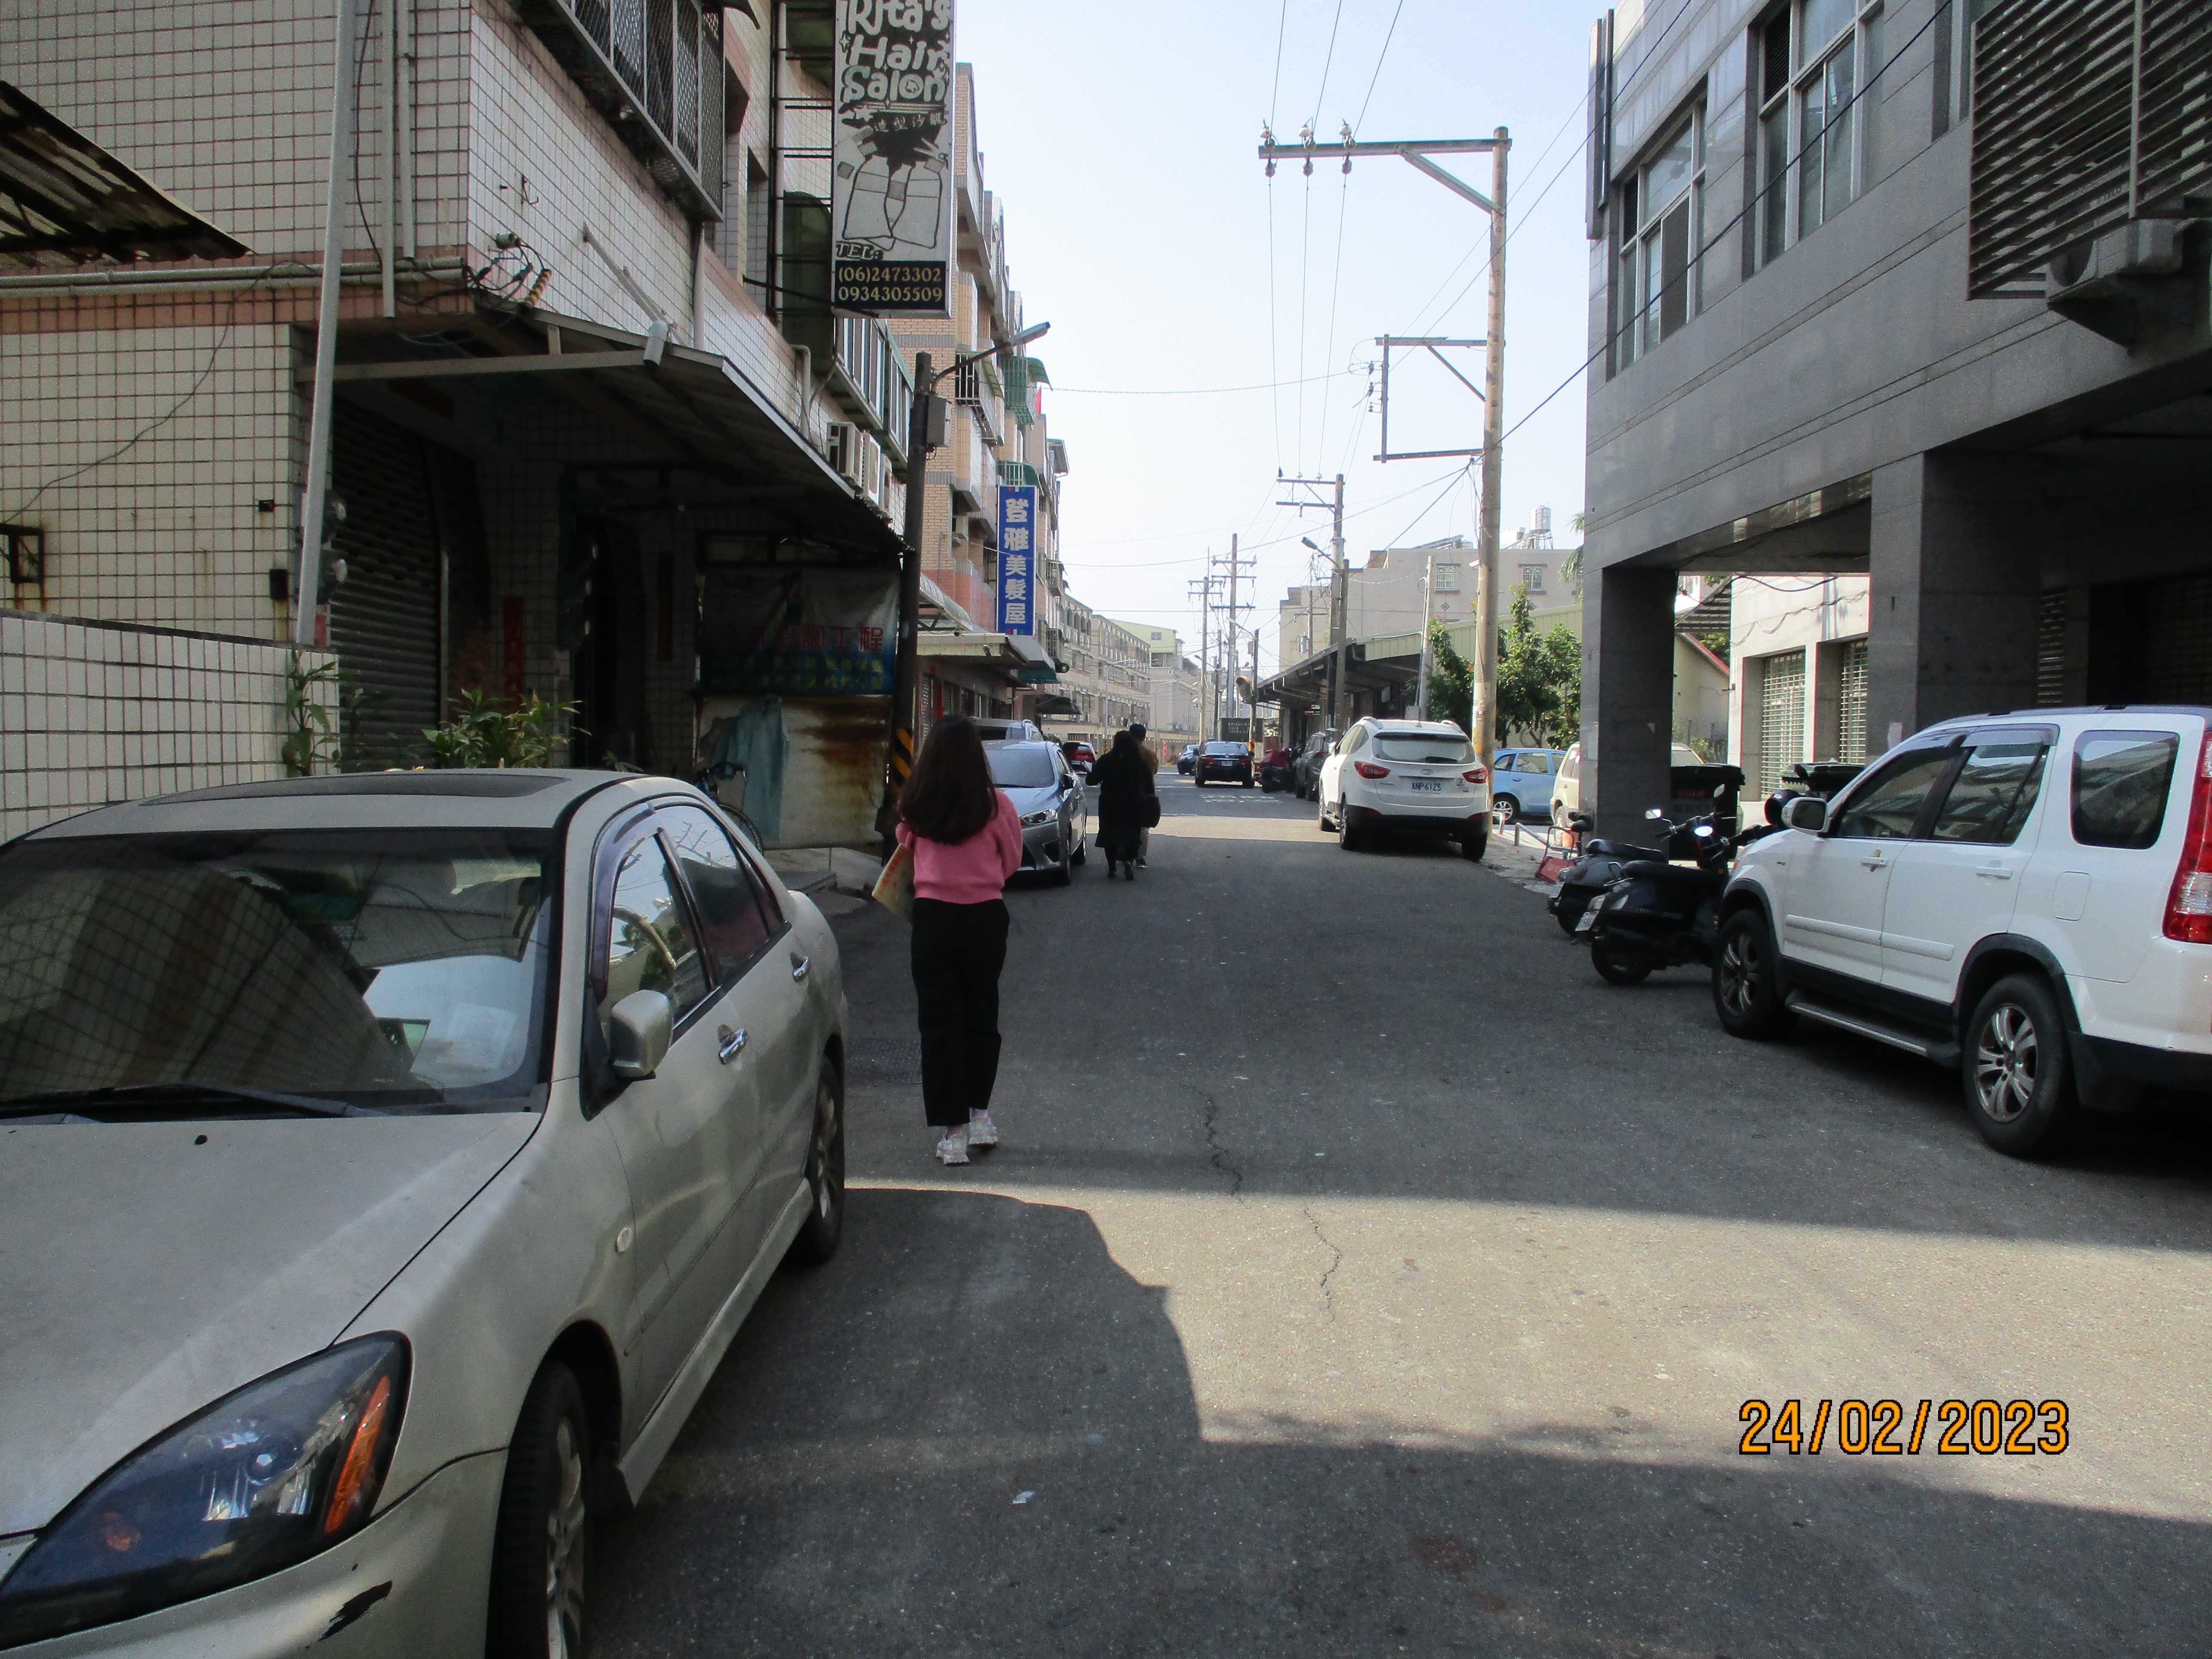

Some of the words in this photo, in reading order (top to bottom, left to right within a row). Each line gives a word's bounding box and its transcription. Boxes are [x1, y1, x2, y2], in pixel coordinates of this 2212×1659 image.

[849, 34, 950, 71] Hair
[843, 65, 948, 103] Salon
[839, 266, 942, 283] (06)2473302
[838, 286, 943, 302] 0934305509
